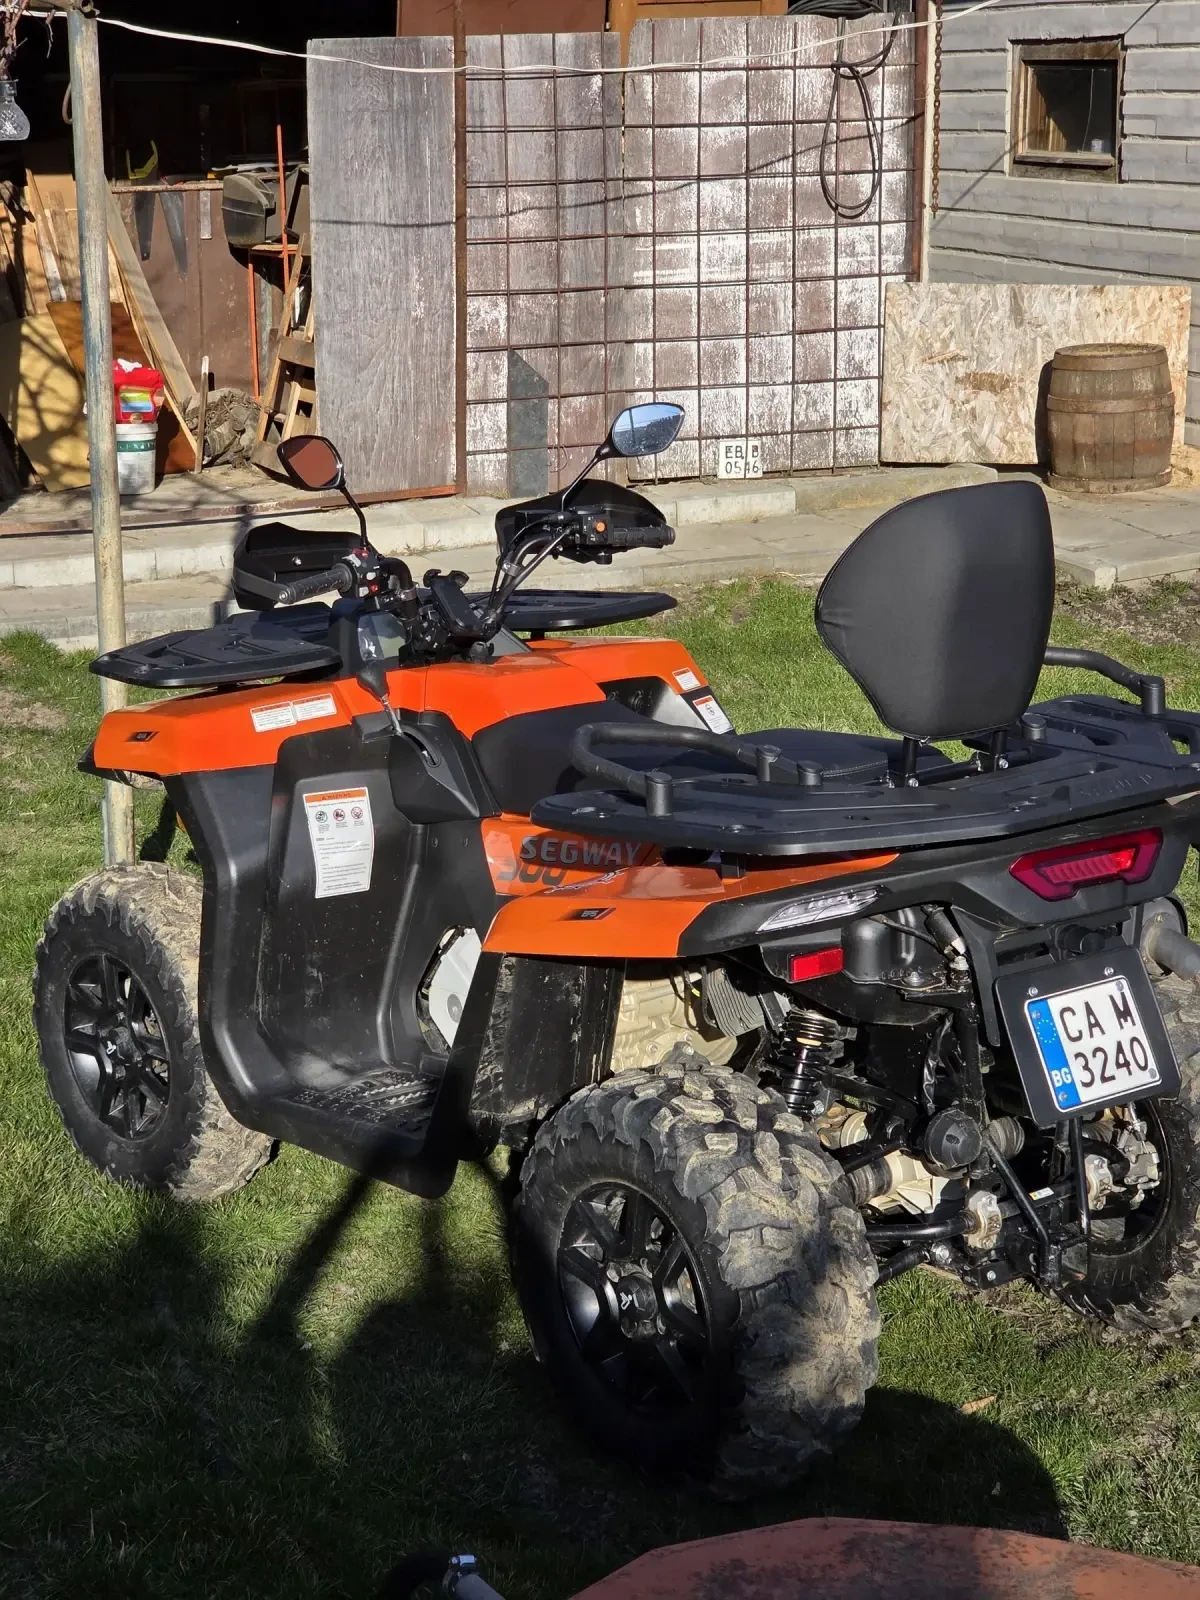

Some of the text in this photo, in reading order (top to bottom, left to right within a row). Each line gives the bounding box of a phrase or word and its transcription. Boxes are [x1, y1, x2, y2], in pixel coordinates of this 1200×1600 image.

[725, 445, 743, 459] EB
[520, 836, 641, 867] SEGWAY
[1060, 991, 1136, 1042] CA M
[1050, 1067, 1073, 1087] BG
[1074, 1036, 1148, 1088] 3240
